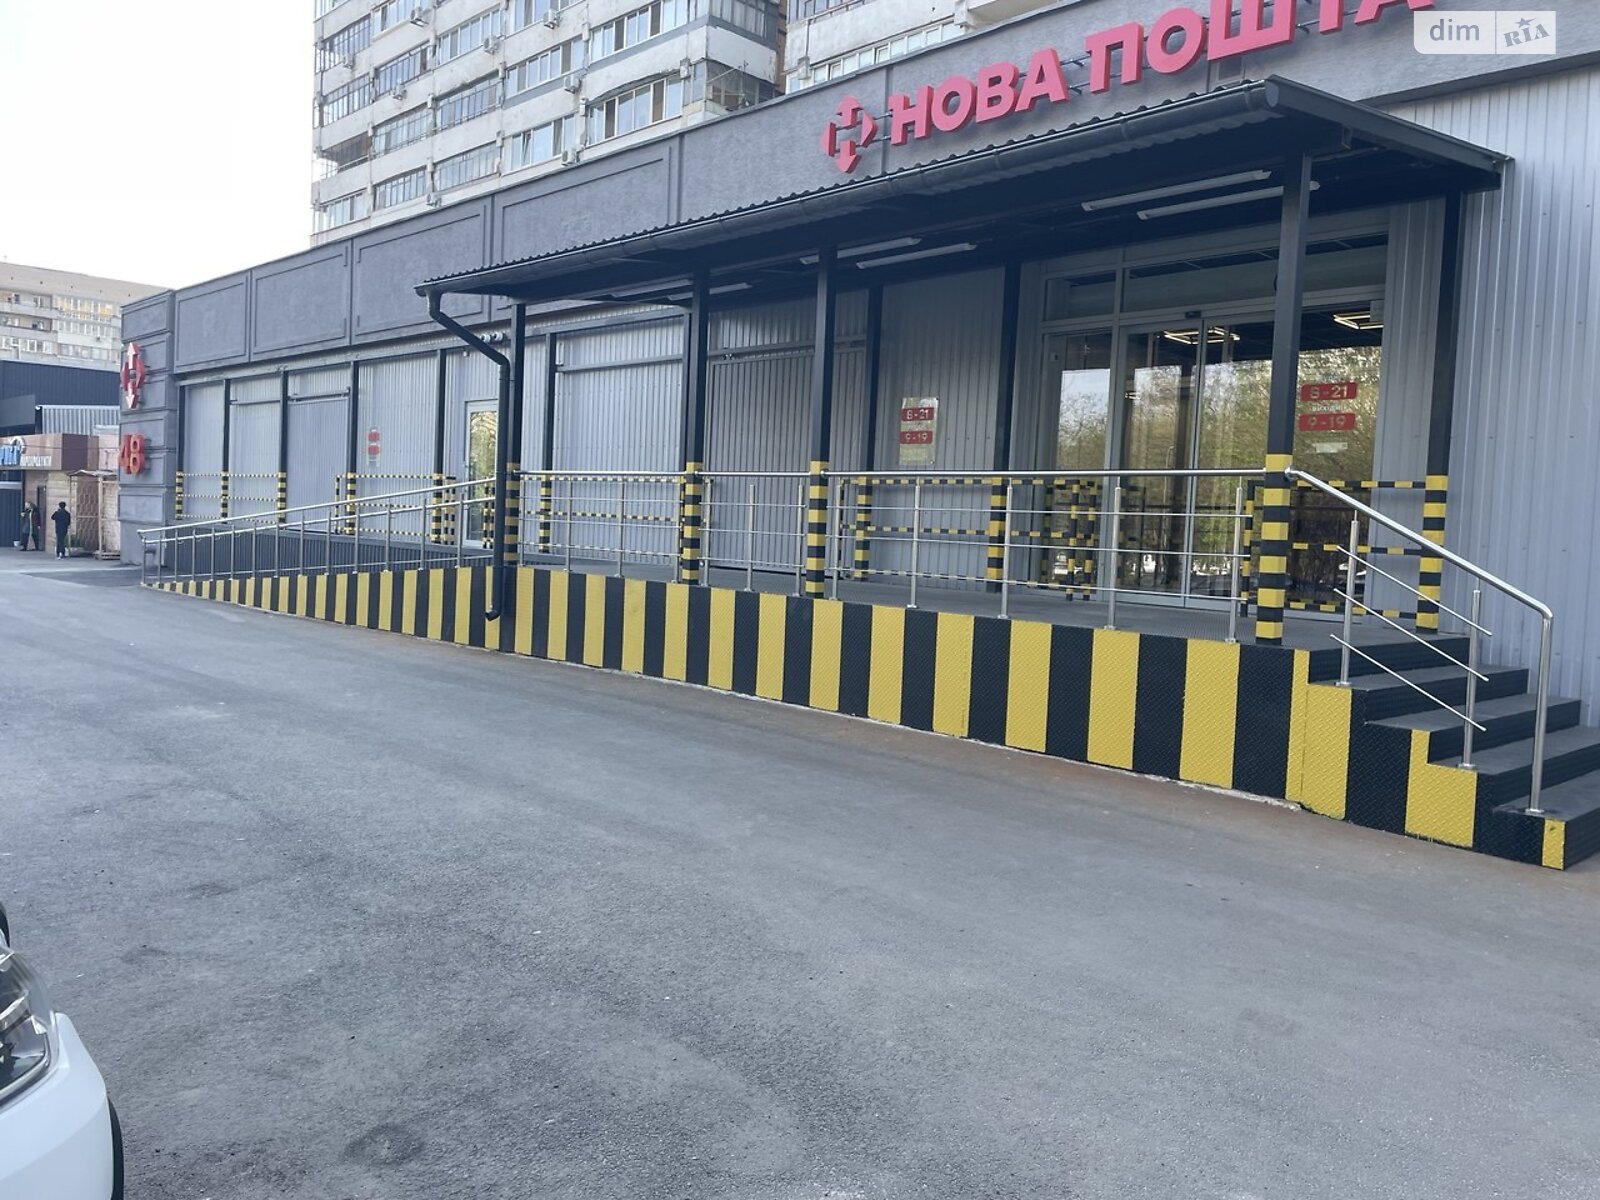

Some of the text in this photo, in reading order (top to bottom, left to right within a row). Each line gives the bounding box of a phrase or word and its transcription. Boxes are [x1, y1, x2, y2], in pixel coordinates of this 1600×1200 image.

[888, 0, 1435, 146] НОВА ПОШ
[118, 433, 145, 475] 48
